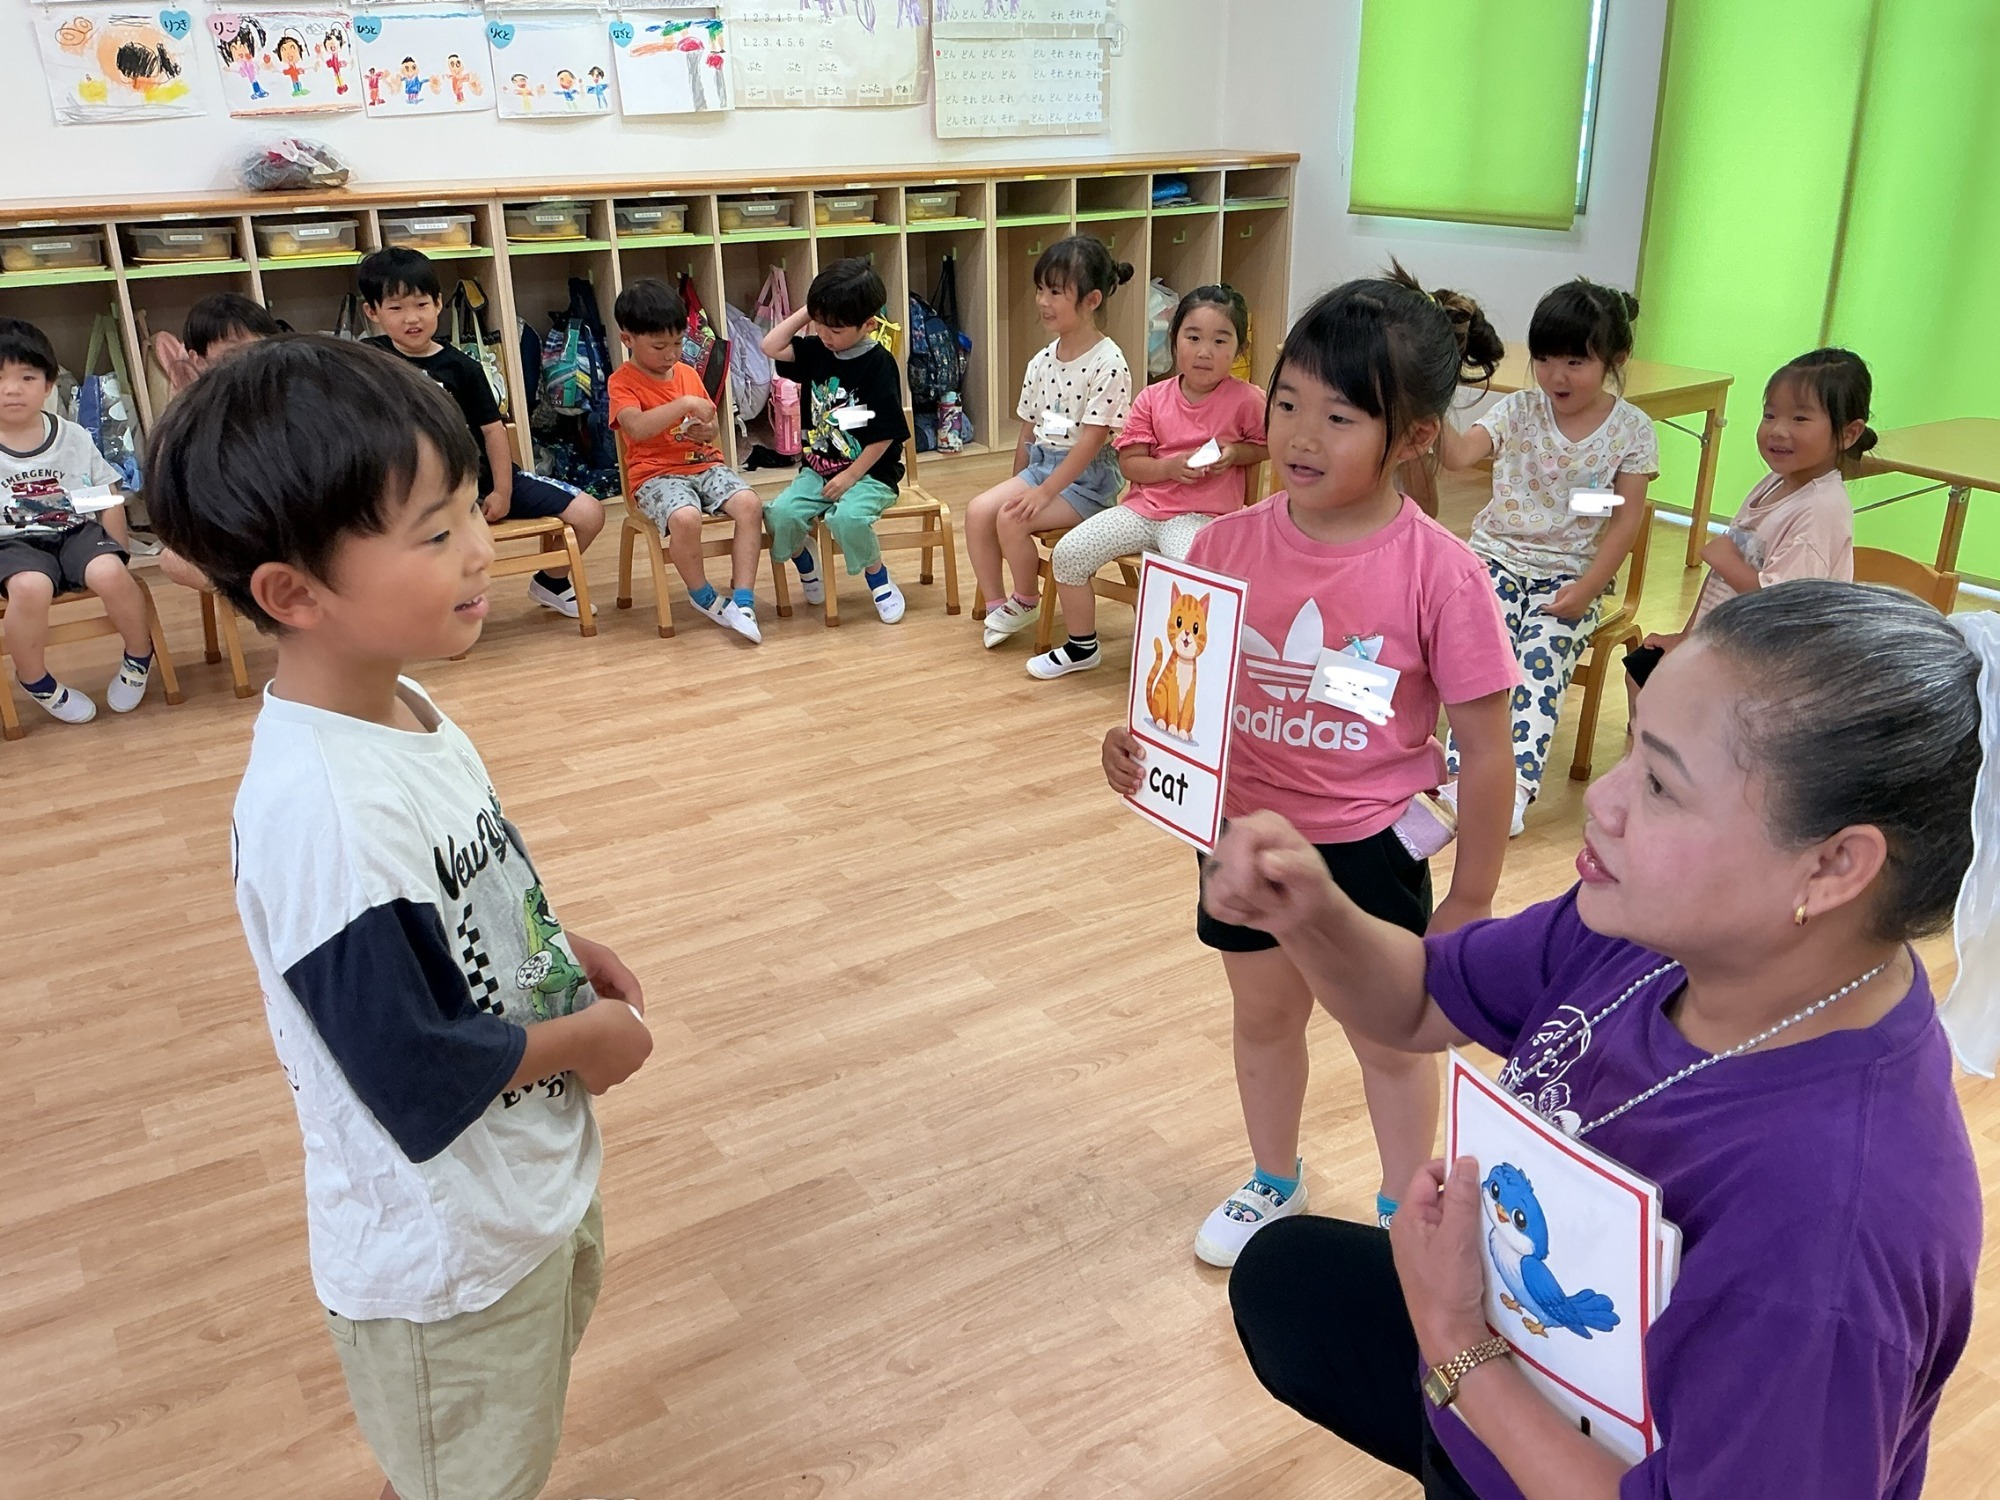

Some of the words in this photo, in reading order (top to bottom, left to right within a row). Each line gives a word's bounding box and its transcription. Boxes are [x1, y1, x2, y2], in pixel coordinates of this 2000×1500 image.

[214, 22, 236, 35] りこ
[491, 28, 510, 40] りくと
[1, 469, 65, 488] EMERGENCY
[1234, 704, 1368, 751] adidas
[1150, 767, 1188, 806] cat
